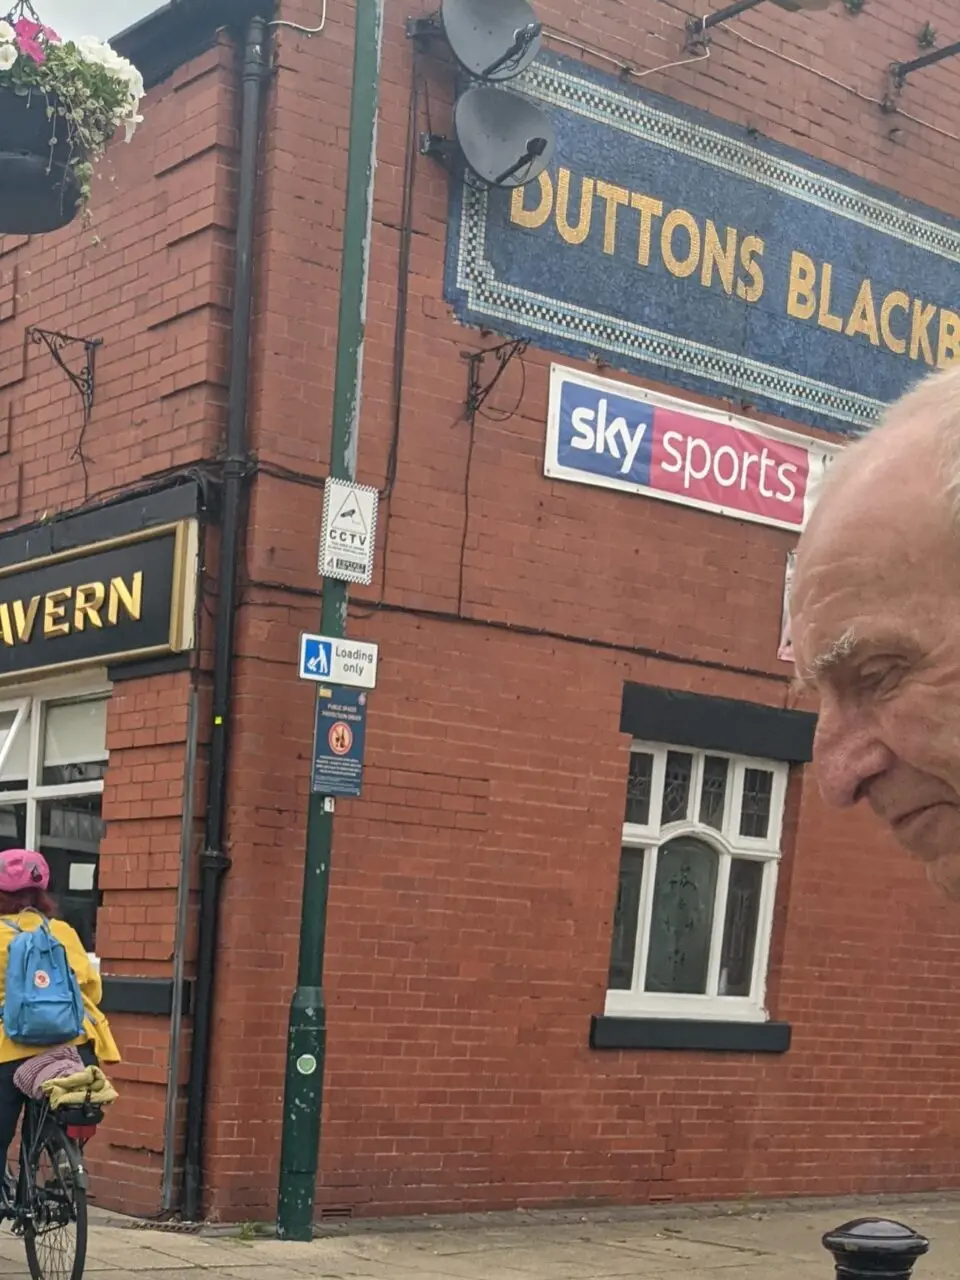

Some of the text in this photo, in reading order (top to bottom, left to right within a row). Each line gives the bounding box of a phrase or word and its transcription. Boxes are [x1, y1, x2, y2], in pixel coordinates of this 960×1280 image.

[510, 167, 766, 302] DUTTONS
[571, 399, 800, 502] sky sports
[328, 529, 368, 547] CCTV
[335, 645, 374, 664] Loading
[343, 663, 365, 676] only
